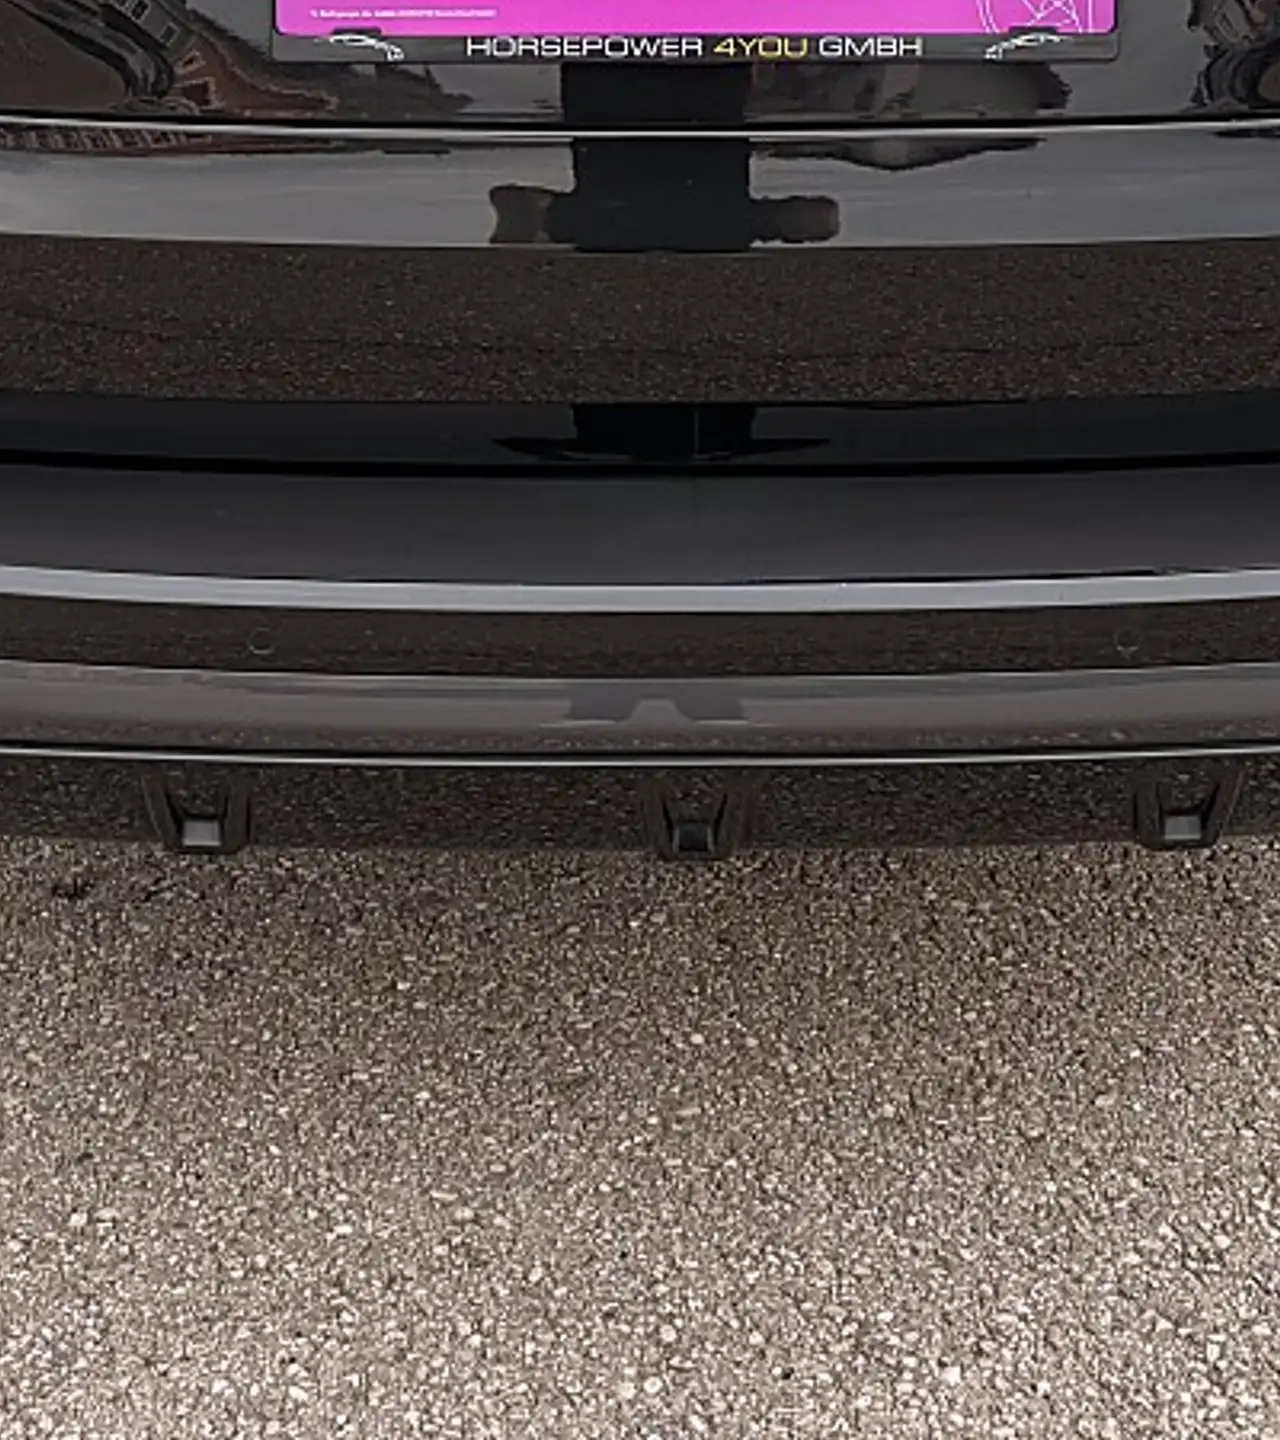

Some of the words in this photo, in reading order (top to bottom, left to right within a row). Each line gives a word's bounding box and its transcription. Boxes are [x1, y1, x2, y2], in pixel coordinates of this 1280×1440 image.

[466, 35, 703, 58] HORSEPOWER
[713, 35, 808, 58] 4YOU
[818, 35, 923, 58] GMBH
